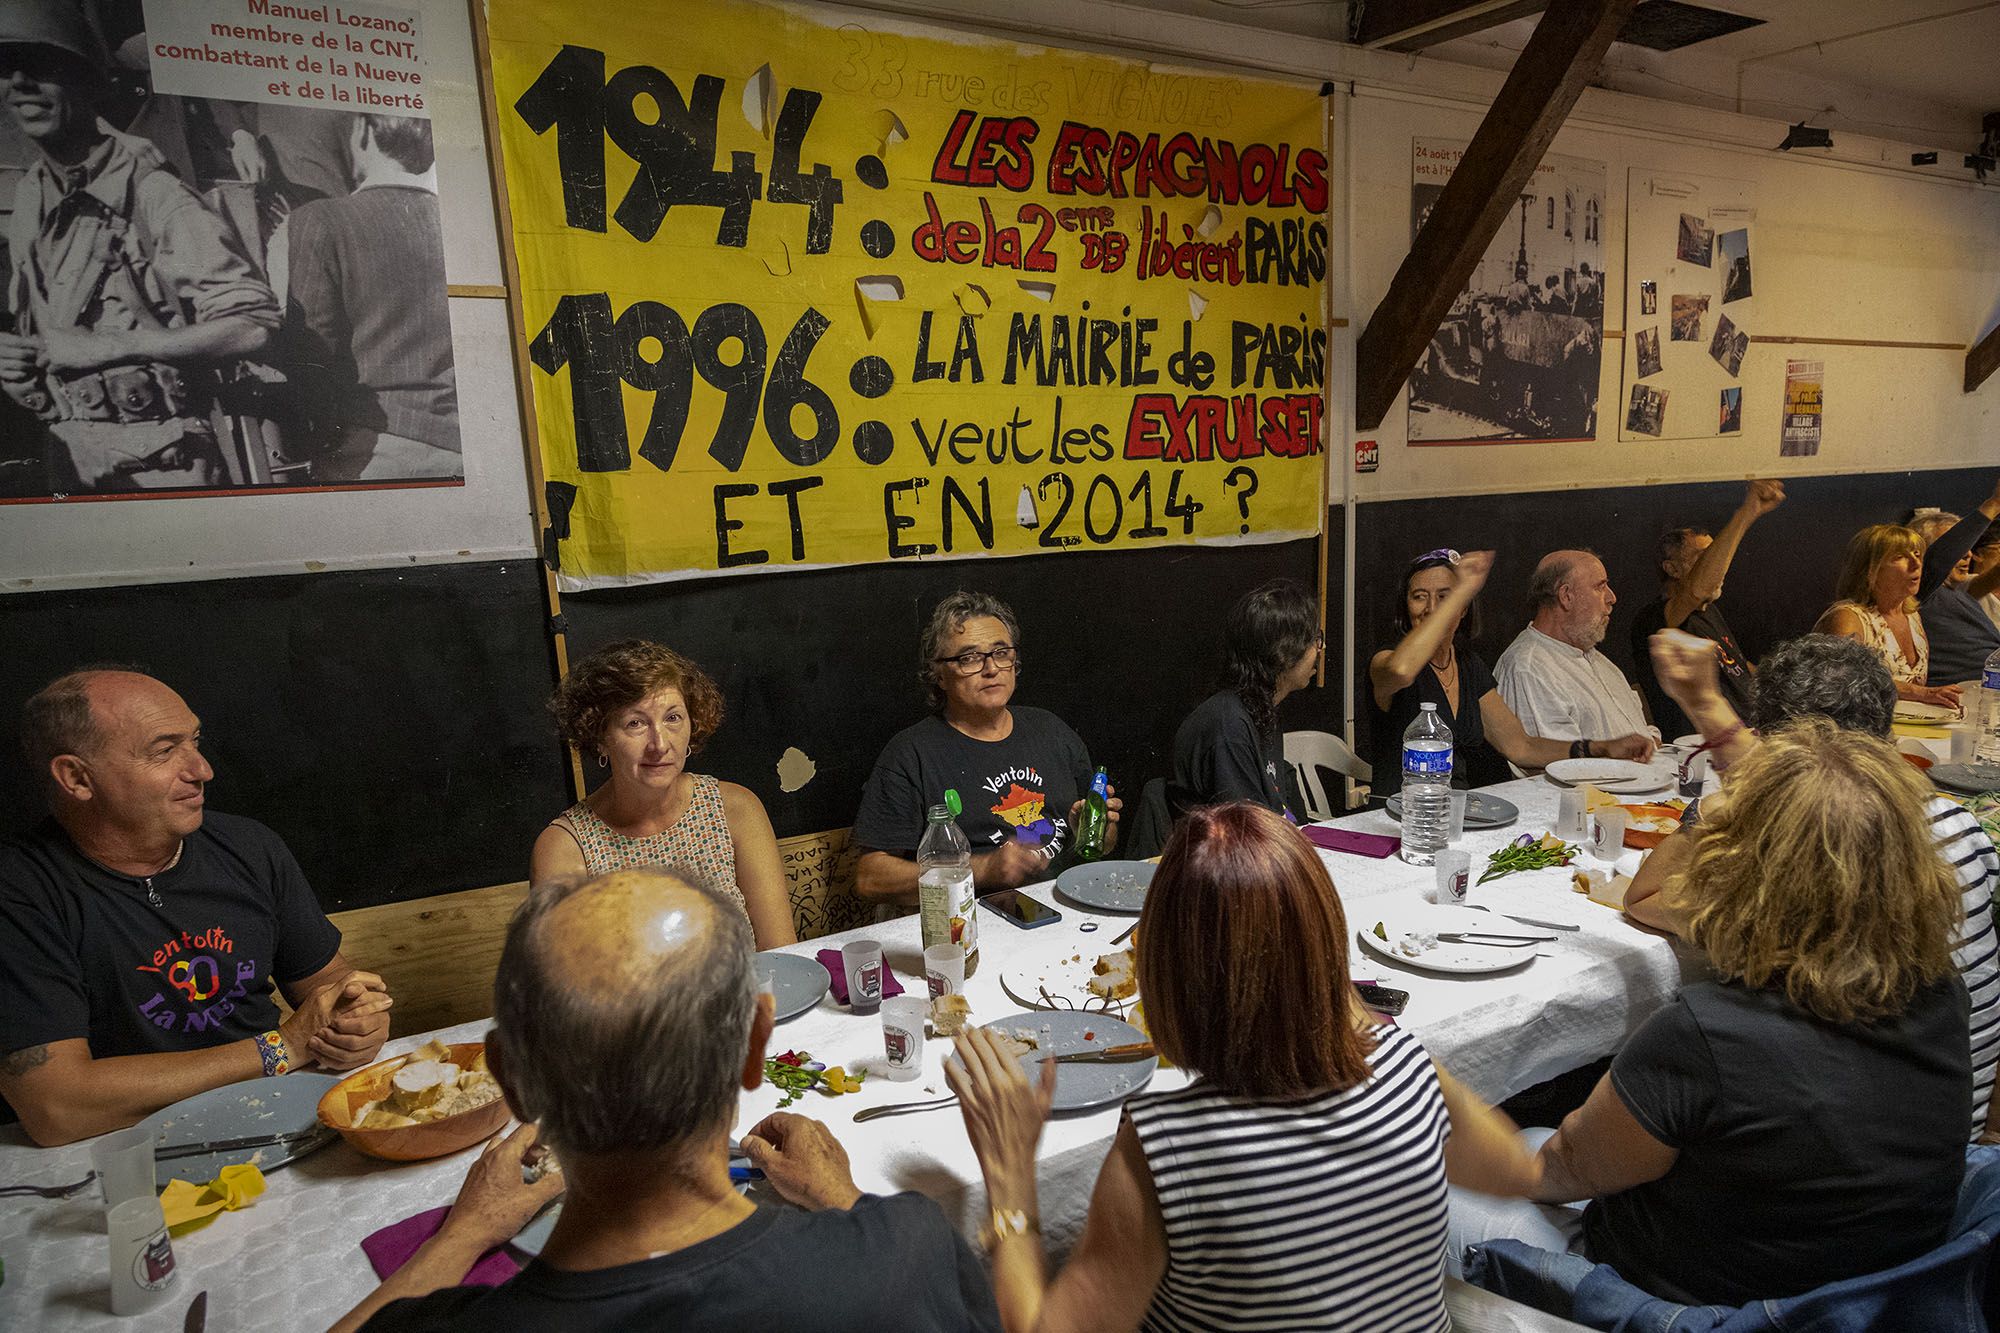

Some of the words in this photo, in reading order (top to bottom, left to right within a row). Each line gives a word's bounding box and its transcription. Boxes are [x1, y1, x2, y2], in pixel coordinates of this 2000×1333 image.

[249, 0, 329, 23] Manuel
[336, 8, 416, 36] Lozano,
[210, 22, 304, 46] membre
[311, 31, 338, 50] de
[345, 34, 363, 53] la
[370, 38, 419, 62] CNT,
[155, 43, 289, 71] combattant
[296, 55, 323, 74] de
[330, 58, 348, 77] la
[354, 62, 422, 85] Nueve
[832, 22, 908, 98] 33
[915, 68, 985, 105] rue
[992, 64, 1053, 114] des
[1061, 65, 1242, 128] VIGNOLES
[267, 80, 291, 97] et
[298, 81, 325, 100] de
[332, 84, 350, 102] la
[356, 86, 424, 110] liberté
[932, 110, 1041, 192] LES
[1047, 121, 1329, 214] ESPAGNOLS
[1416, 146, 1427, 157] 24
[1430, 149, 1450, 160] août
[1453, 151, 1464, 161] 19
[1416, 165, 1430, 175] est
[1432, 164, 1438, 175] à
[1536, 164, 1555, 174] ueve
[912, 192, 976, 265] de
[978, 196, 1022, 269] la
[1079, 231, 1130, 273] DB
[912, 310, 984, 384] LA
[1167, 320, 1216, 389] de
[911, 406, 1043, 466] veut
[1049, 395, 1115, 465] les
[1123, 393, 1325, 463] EXPULSER
[1356, 449, 1378, 464] CNT
[713, 476, 823, 568] ET
[884, 475, 994, 560] EN
[1038, 469, 1204, 548] 2014
[1223, 466, 1259, 536] ?
[982, 766, 1043, 794] Ventolin
